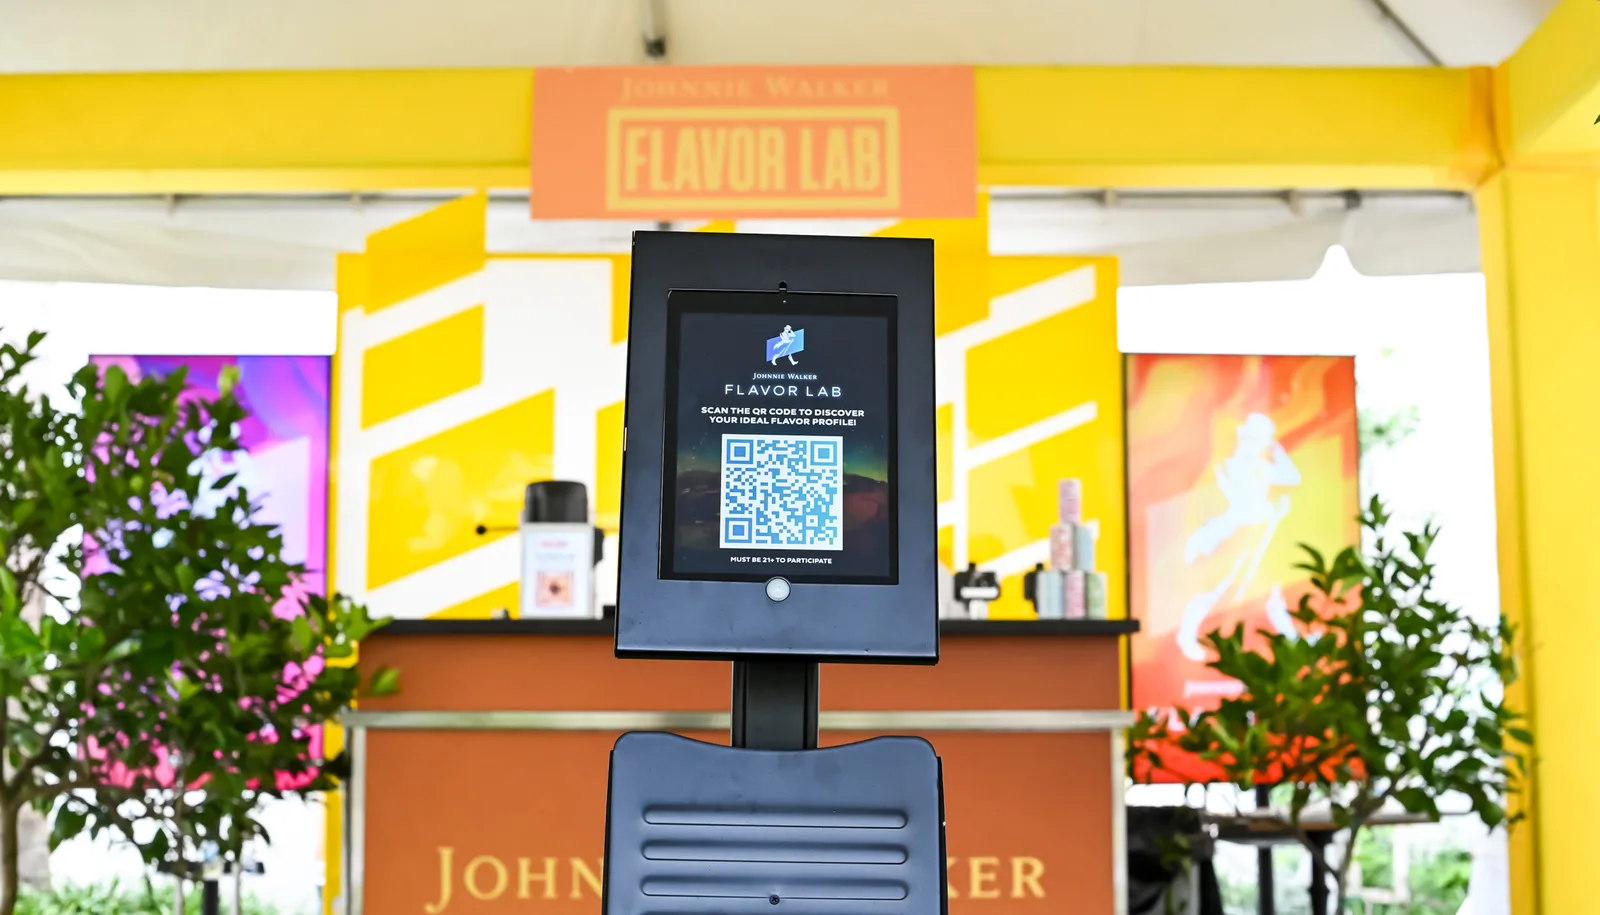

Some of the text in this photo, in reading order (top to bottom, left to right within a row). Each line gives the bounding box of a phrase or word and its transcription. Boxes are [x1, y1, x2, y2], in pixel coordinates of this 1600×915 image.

[620, 74, 889, 103] JOHNNIE WALKER
[624, 127, 880, 191] FLAVOR LAB
[753, 372, 785, 381] JOHNNIE
[724, 384, 842, 398] FLAVOR LAB
[701, 406, 865, 417] SCAN THE QR CODE TO DISCOVER
[709, 416, 857, 426] YOUR IDEAL FLAVOR PROFILE!
[423, 845, 1046, 915] JOHN ER
